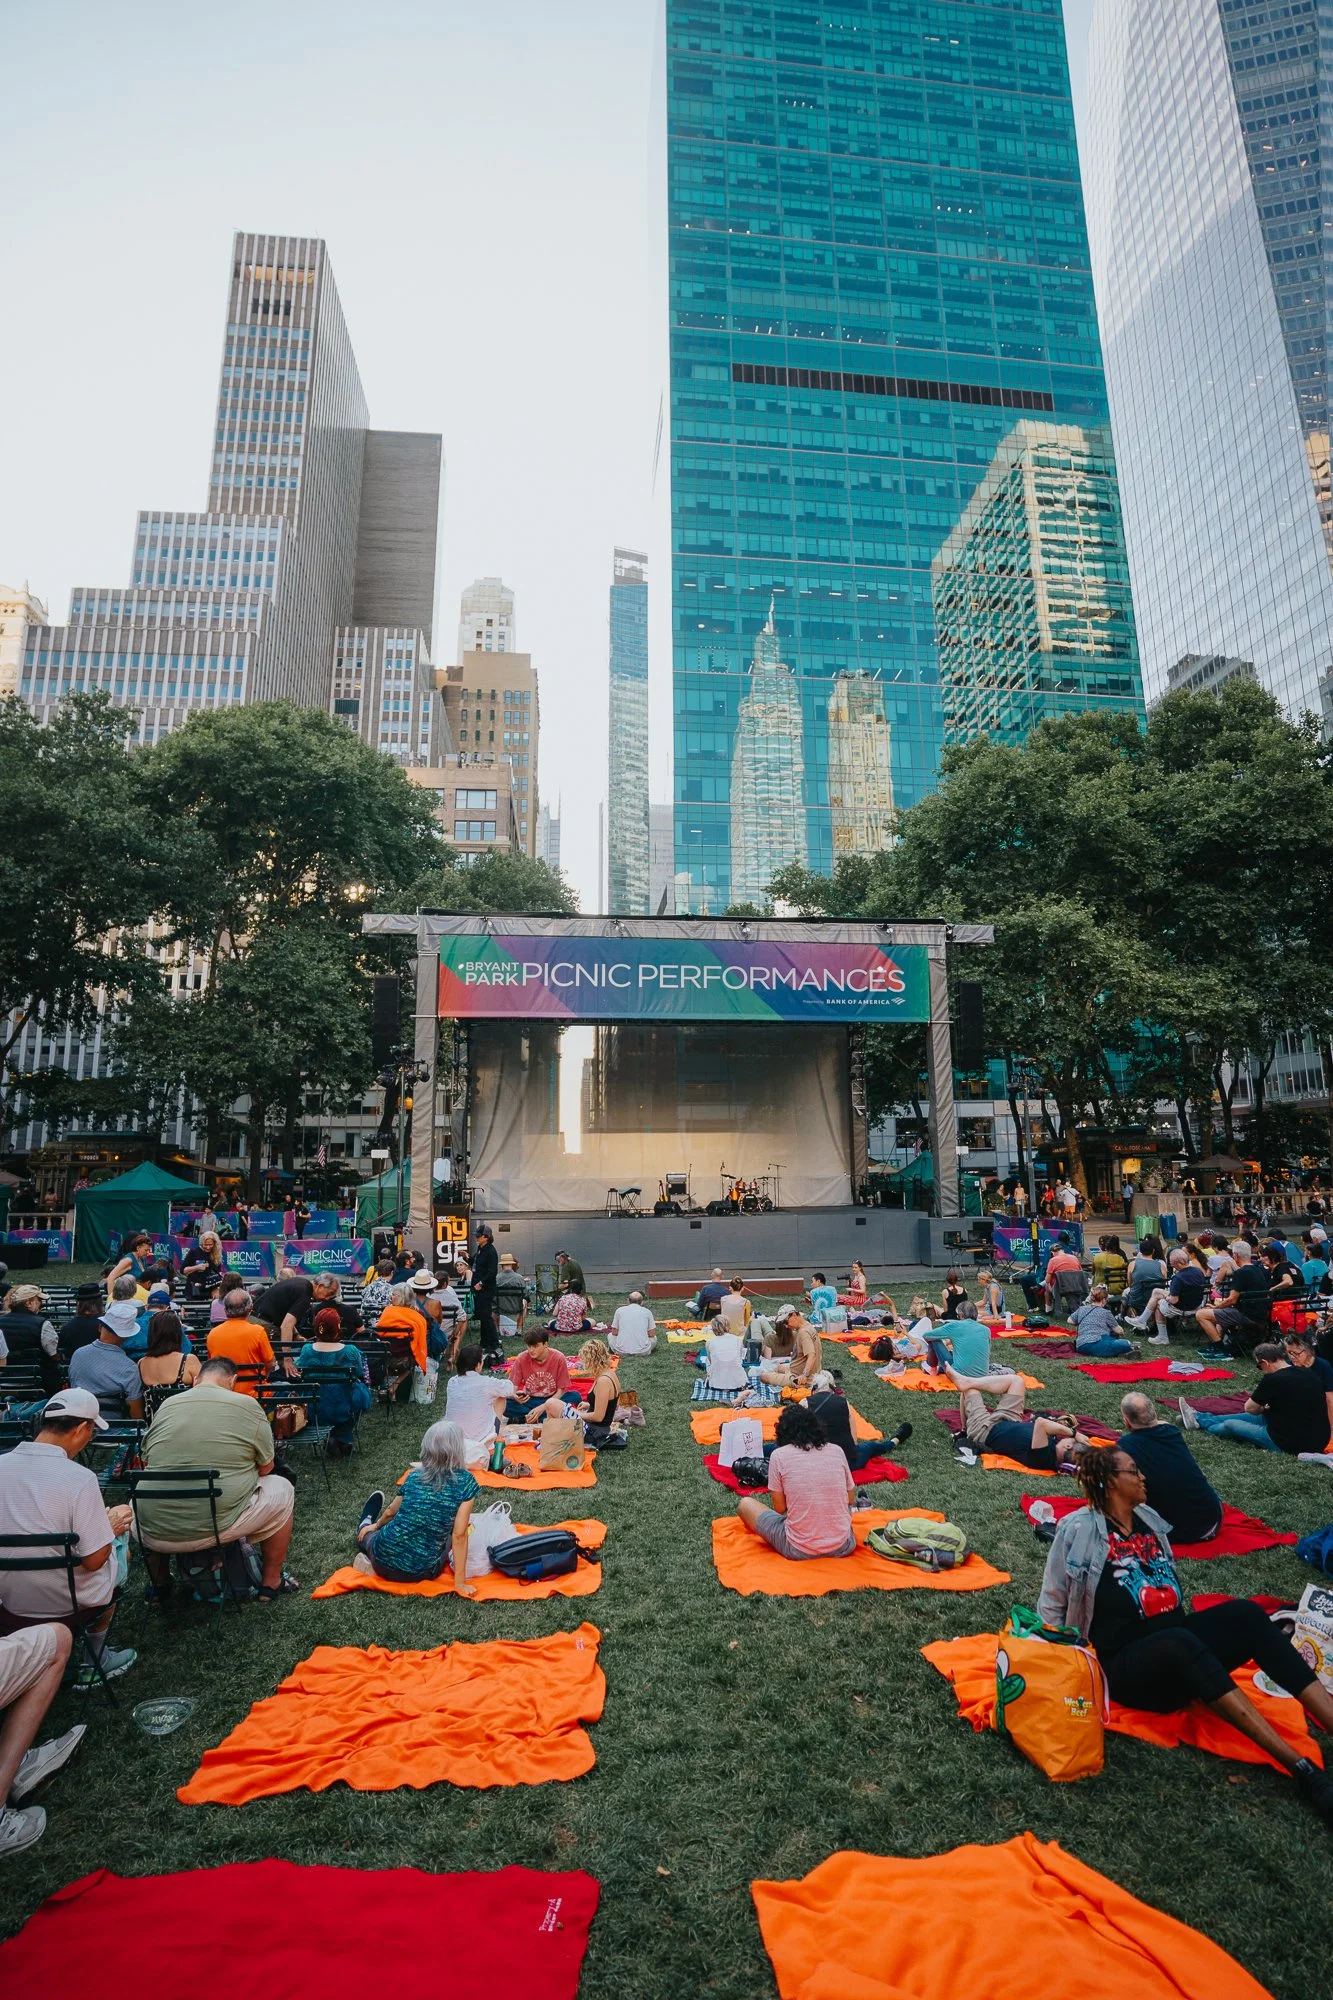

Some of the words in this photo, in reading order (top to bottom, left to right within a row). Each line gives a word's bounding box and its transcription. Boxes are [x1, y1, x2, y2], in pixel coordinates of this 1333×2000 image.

[466, 962, 519, 971] BRYANT
[465, 972, 519, 986] PARK
[522, 962, 631, 988] PICNIC
[638, 964, 906, 993] PERFORMANCES
[232, 1251, 261, 1262] PICNIC
[311, 1249, 352, 1260] PICNIC
